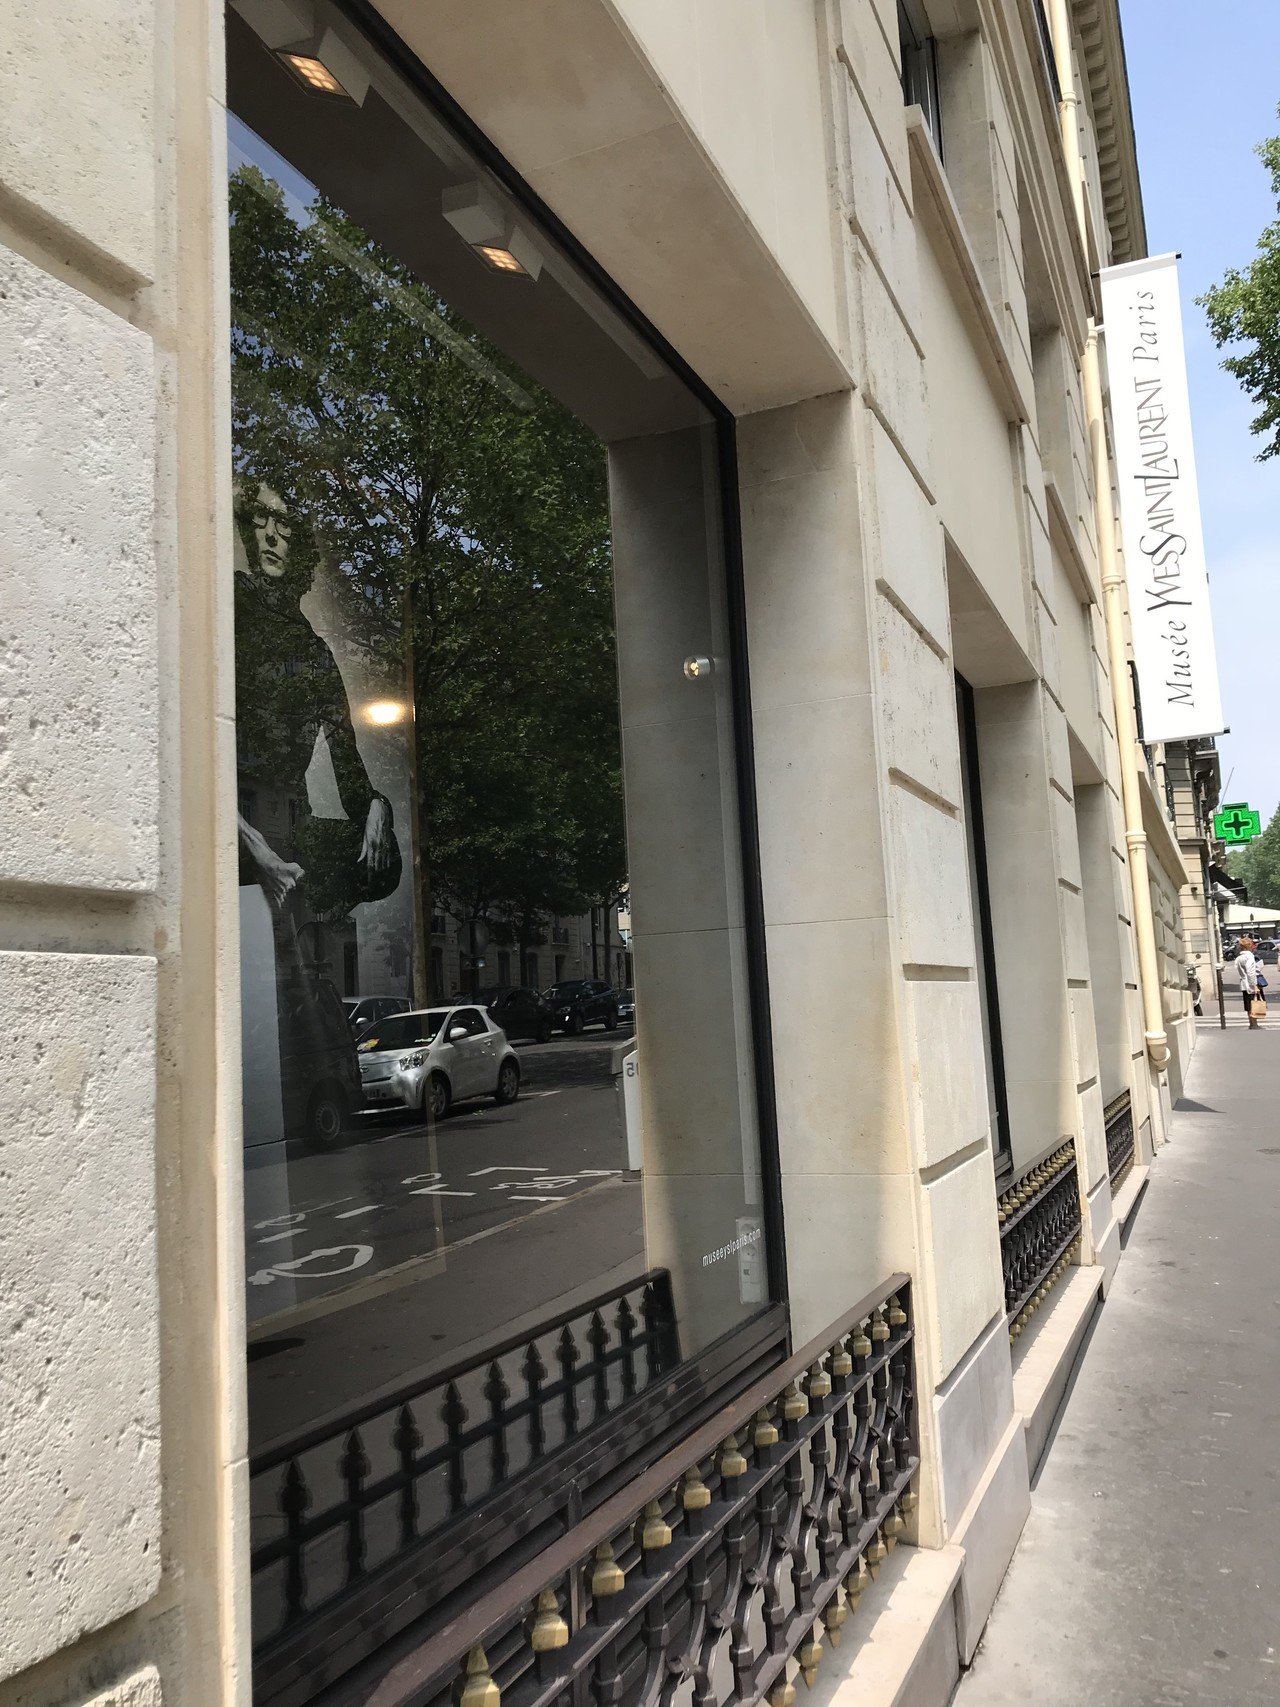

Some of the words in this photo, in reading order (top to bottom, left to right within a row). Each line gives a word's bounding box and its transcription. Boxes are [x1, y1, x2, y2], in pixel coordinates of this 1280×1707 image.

[1129, 291, 1159, 363] Paris
[1161, 620, 1194, 707] Musée
[702, 1228, 761, 1267] museeyslparis.com
